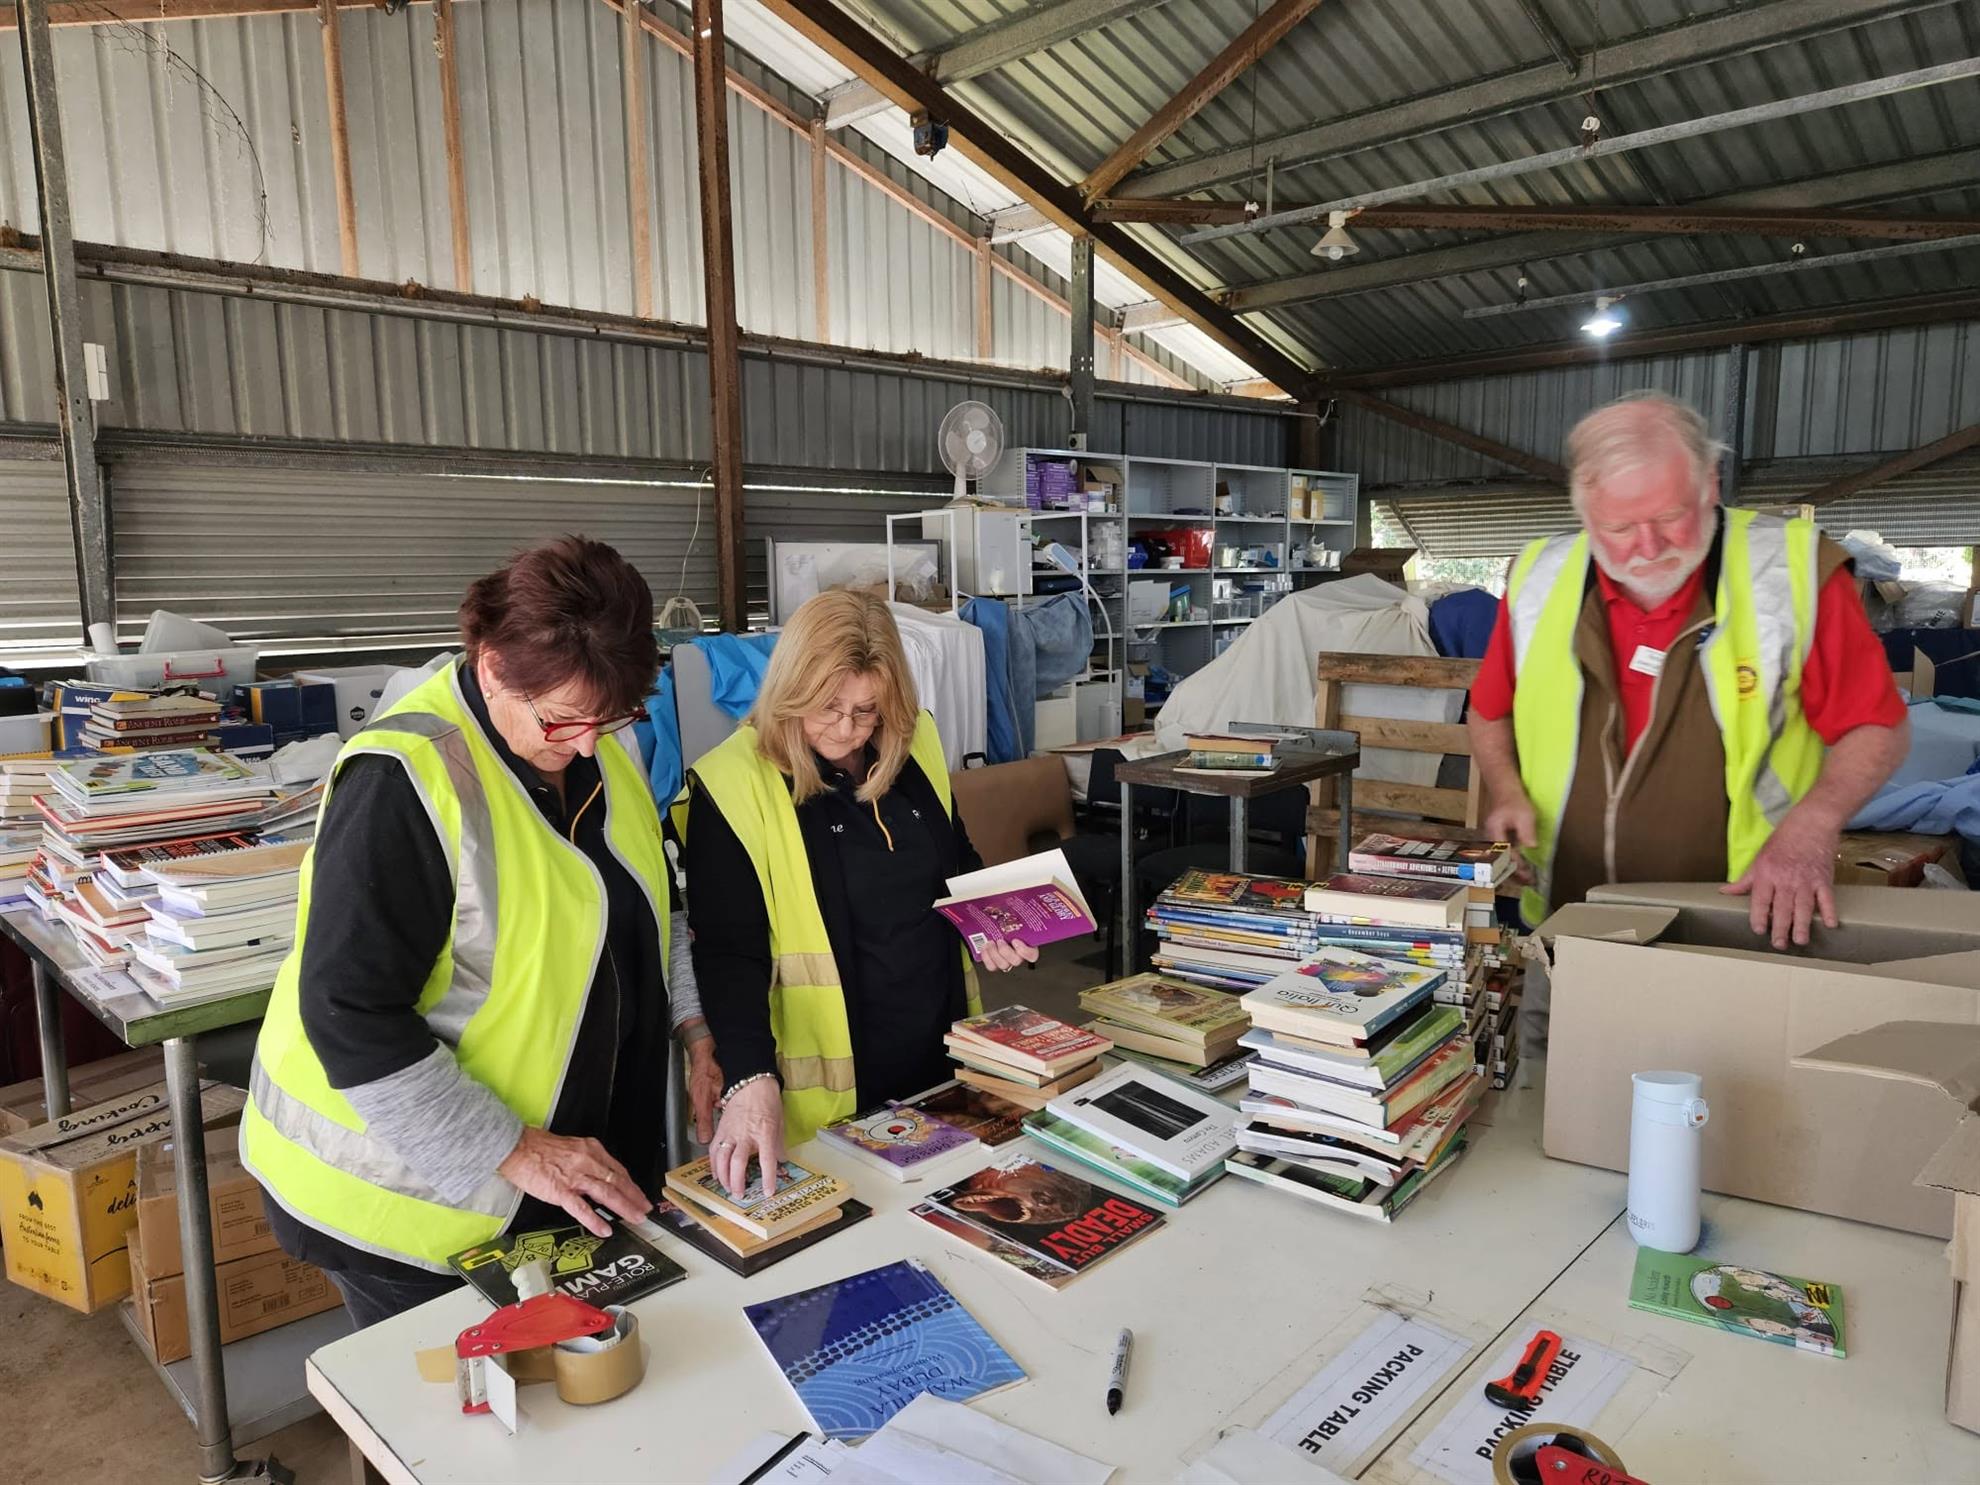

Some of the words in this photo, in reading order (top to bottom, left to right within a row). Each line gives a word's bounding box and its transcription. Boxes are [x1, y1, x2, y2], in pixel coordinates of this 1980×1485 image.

[1182, 1140, 1220, 1164] ADAMS
[1040, 1197, 1142, 1260] DEADLY
[1102, 1212, 1153, 1243] SMALL
[1072, 1244, 1106, 1265] BUT
[573, 1262, 655, 1299] ROLE-PLA
[878, 1366, 944, 1399] DUBAY
[1352, 1344, 1424, 1405] PACKING
[1298, 1404, 1361, 1455] TABLE
